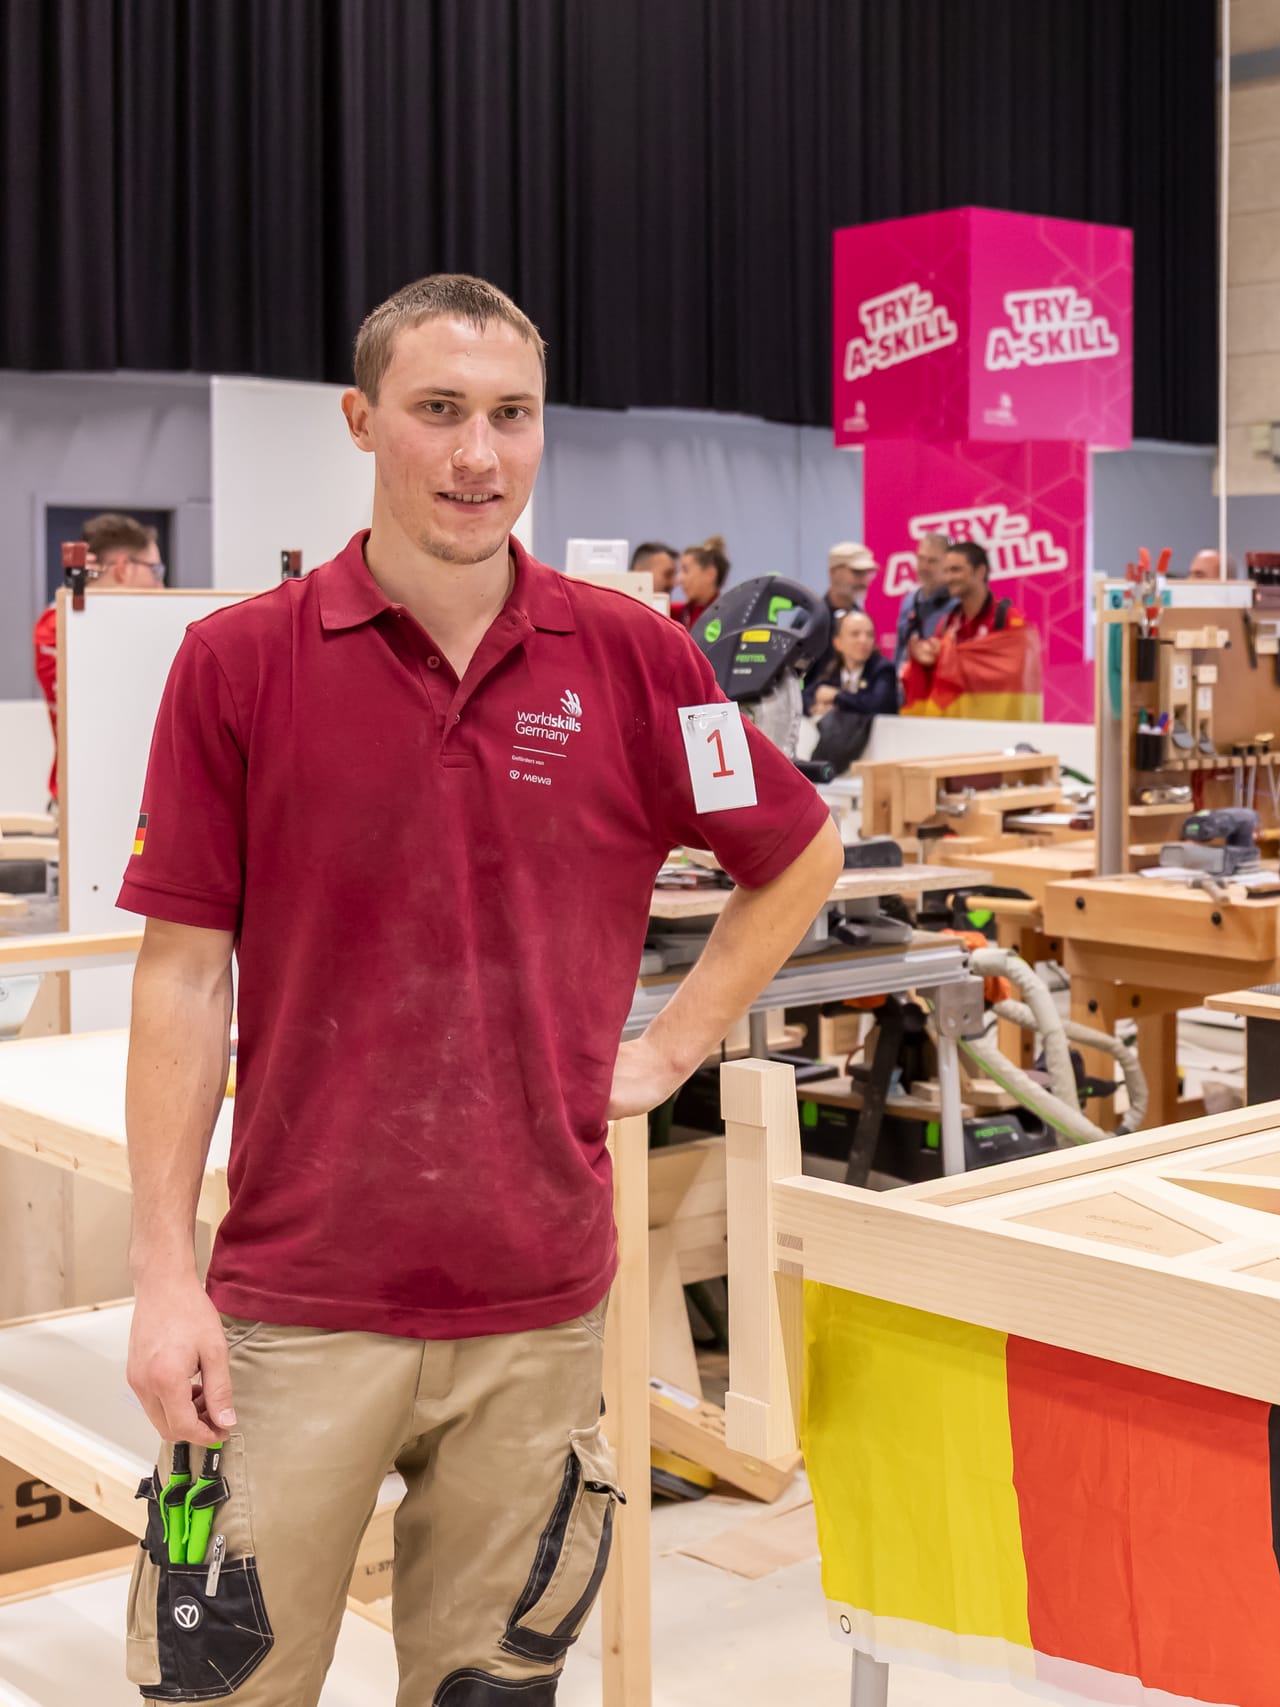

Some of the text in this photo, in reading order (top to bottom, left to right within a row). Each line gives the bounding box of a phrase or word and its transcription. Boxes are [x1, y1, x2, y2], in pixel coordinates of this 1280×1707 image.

[862, 287, 931, 336] TRY-
[1008, 291, 1088, 328] TRY-
[848, 310, 954, 377] A-SKILL
[988, 321, 1115, 366] A-SKILL
[515, 721, 570, 746] Germany
[516, 711, 582, 733] worldskills
[706, 729, 734, 778] 1
